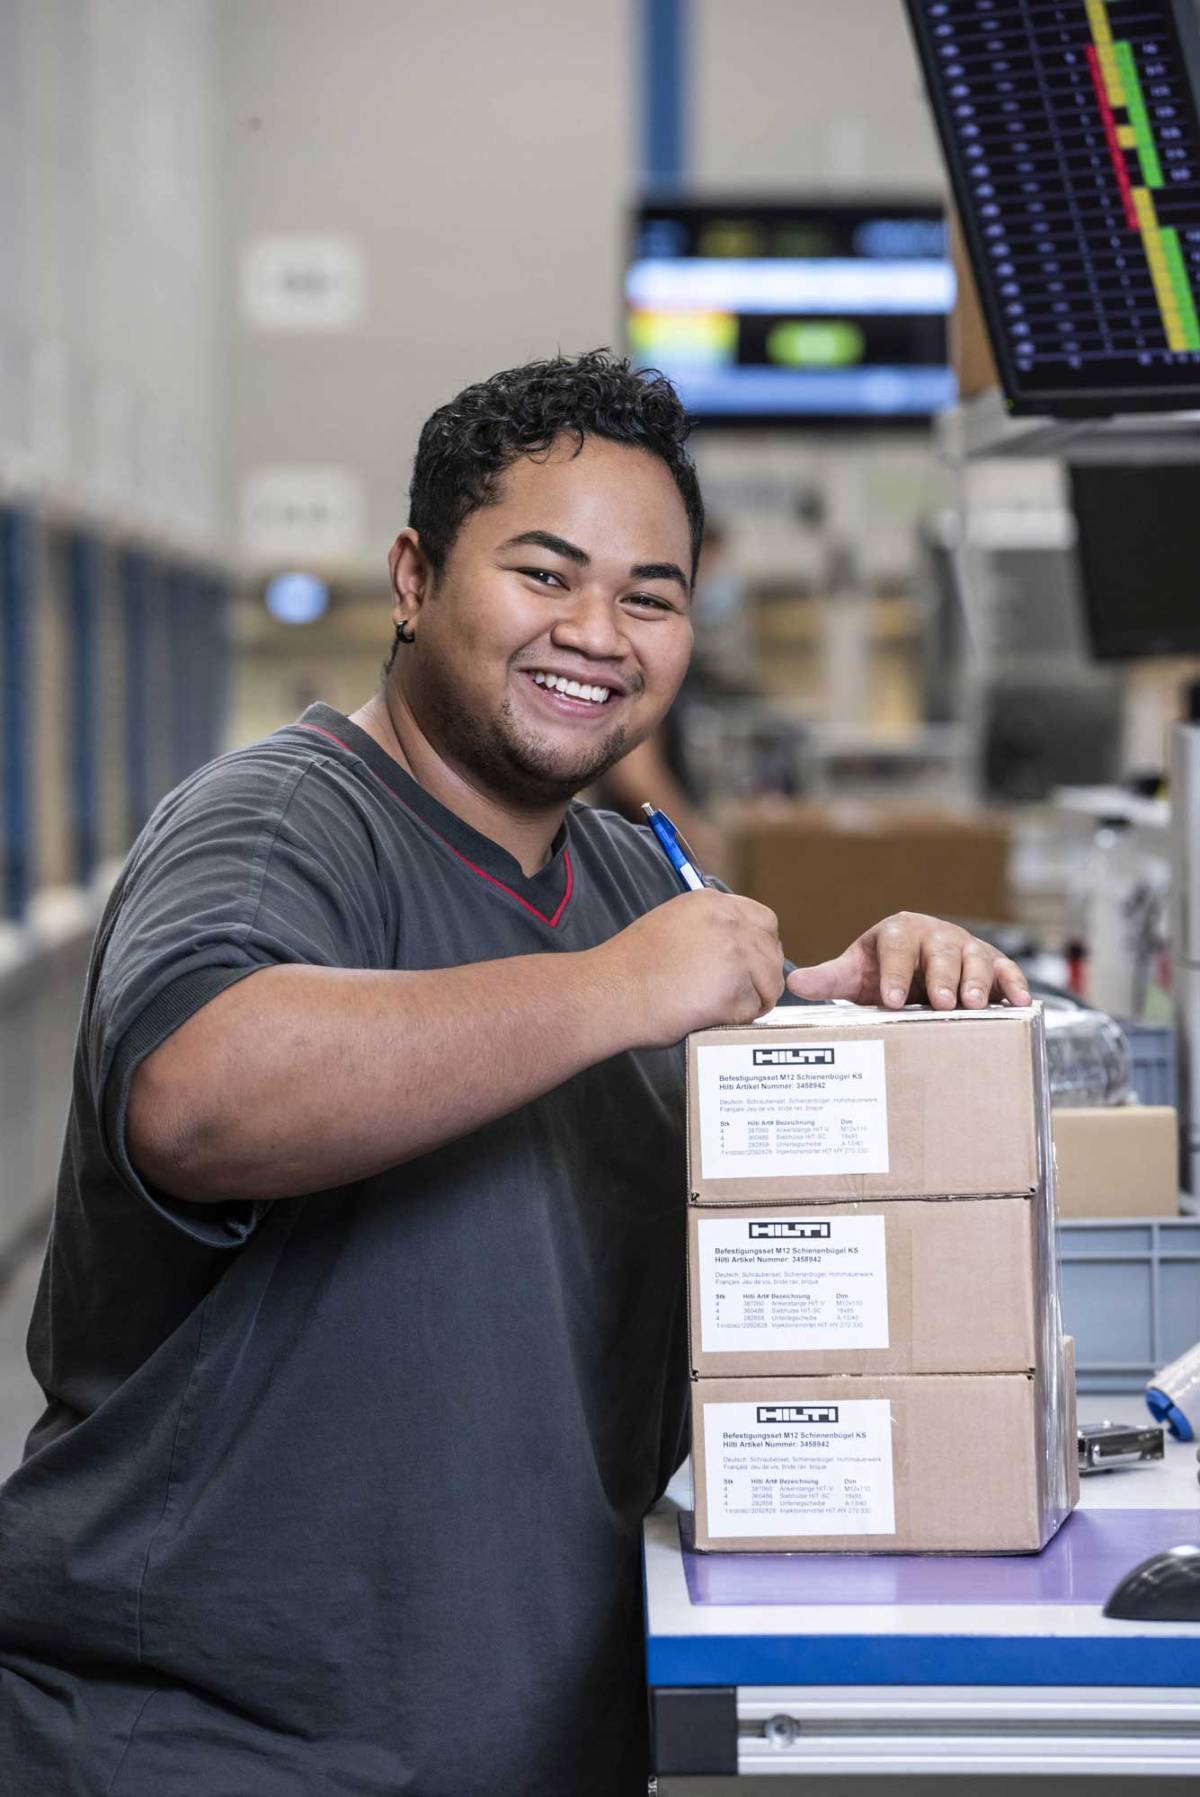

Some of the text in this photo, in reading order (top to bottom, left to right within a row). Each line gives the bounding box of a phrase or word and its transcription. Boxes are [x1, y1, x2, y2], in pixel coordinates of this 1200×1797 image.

[755, 1050, 832, 1064] HILTI
[751, 1224, 828, 1237] HILTI
[759, 1408, 836, 1422] HILTI
[723, 1432, 782, 1440] Befestigungsset
